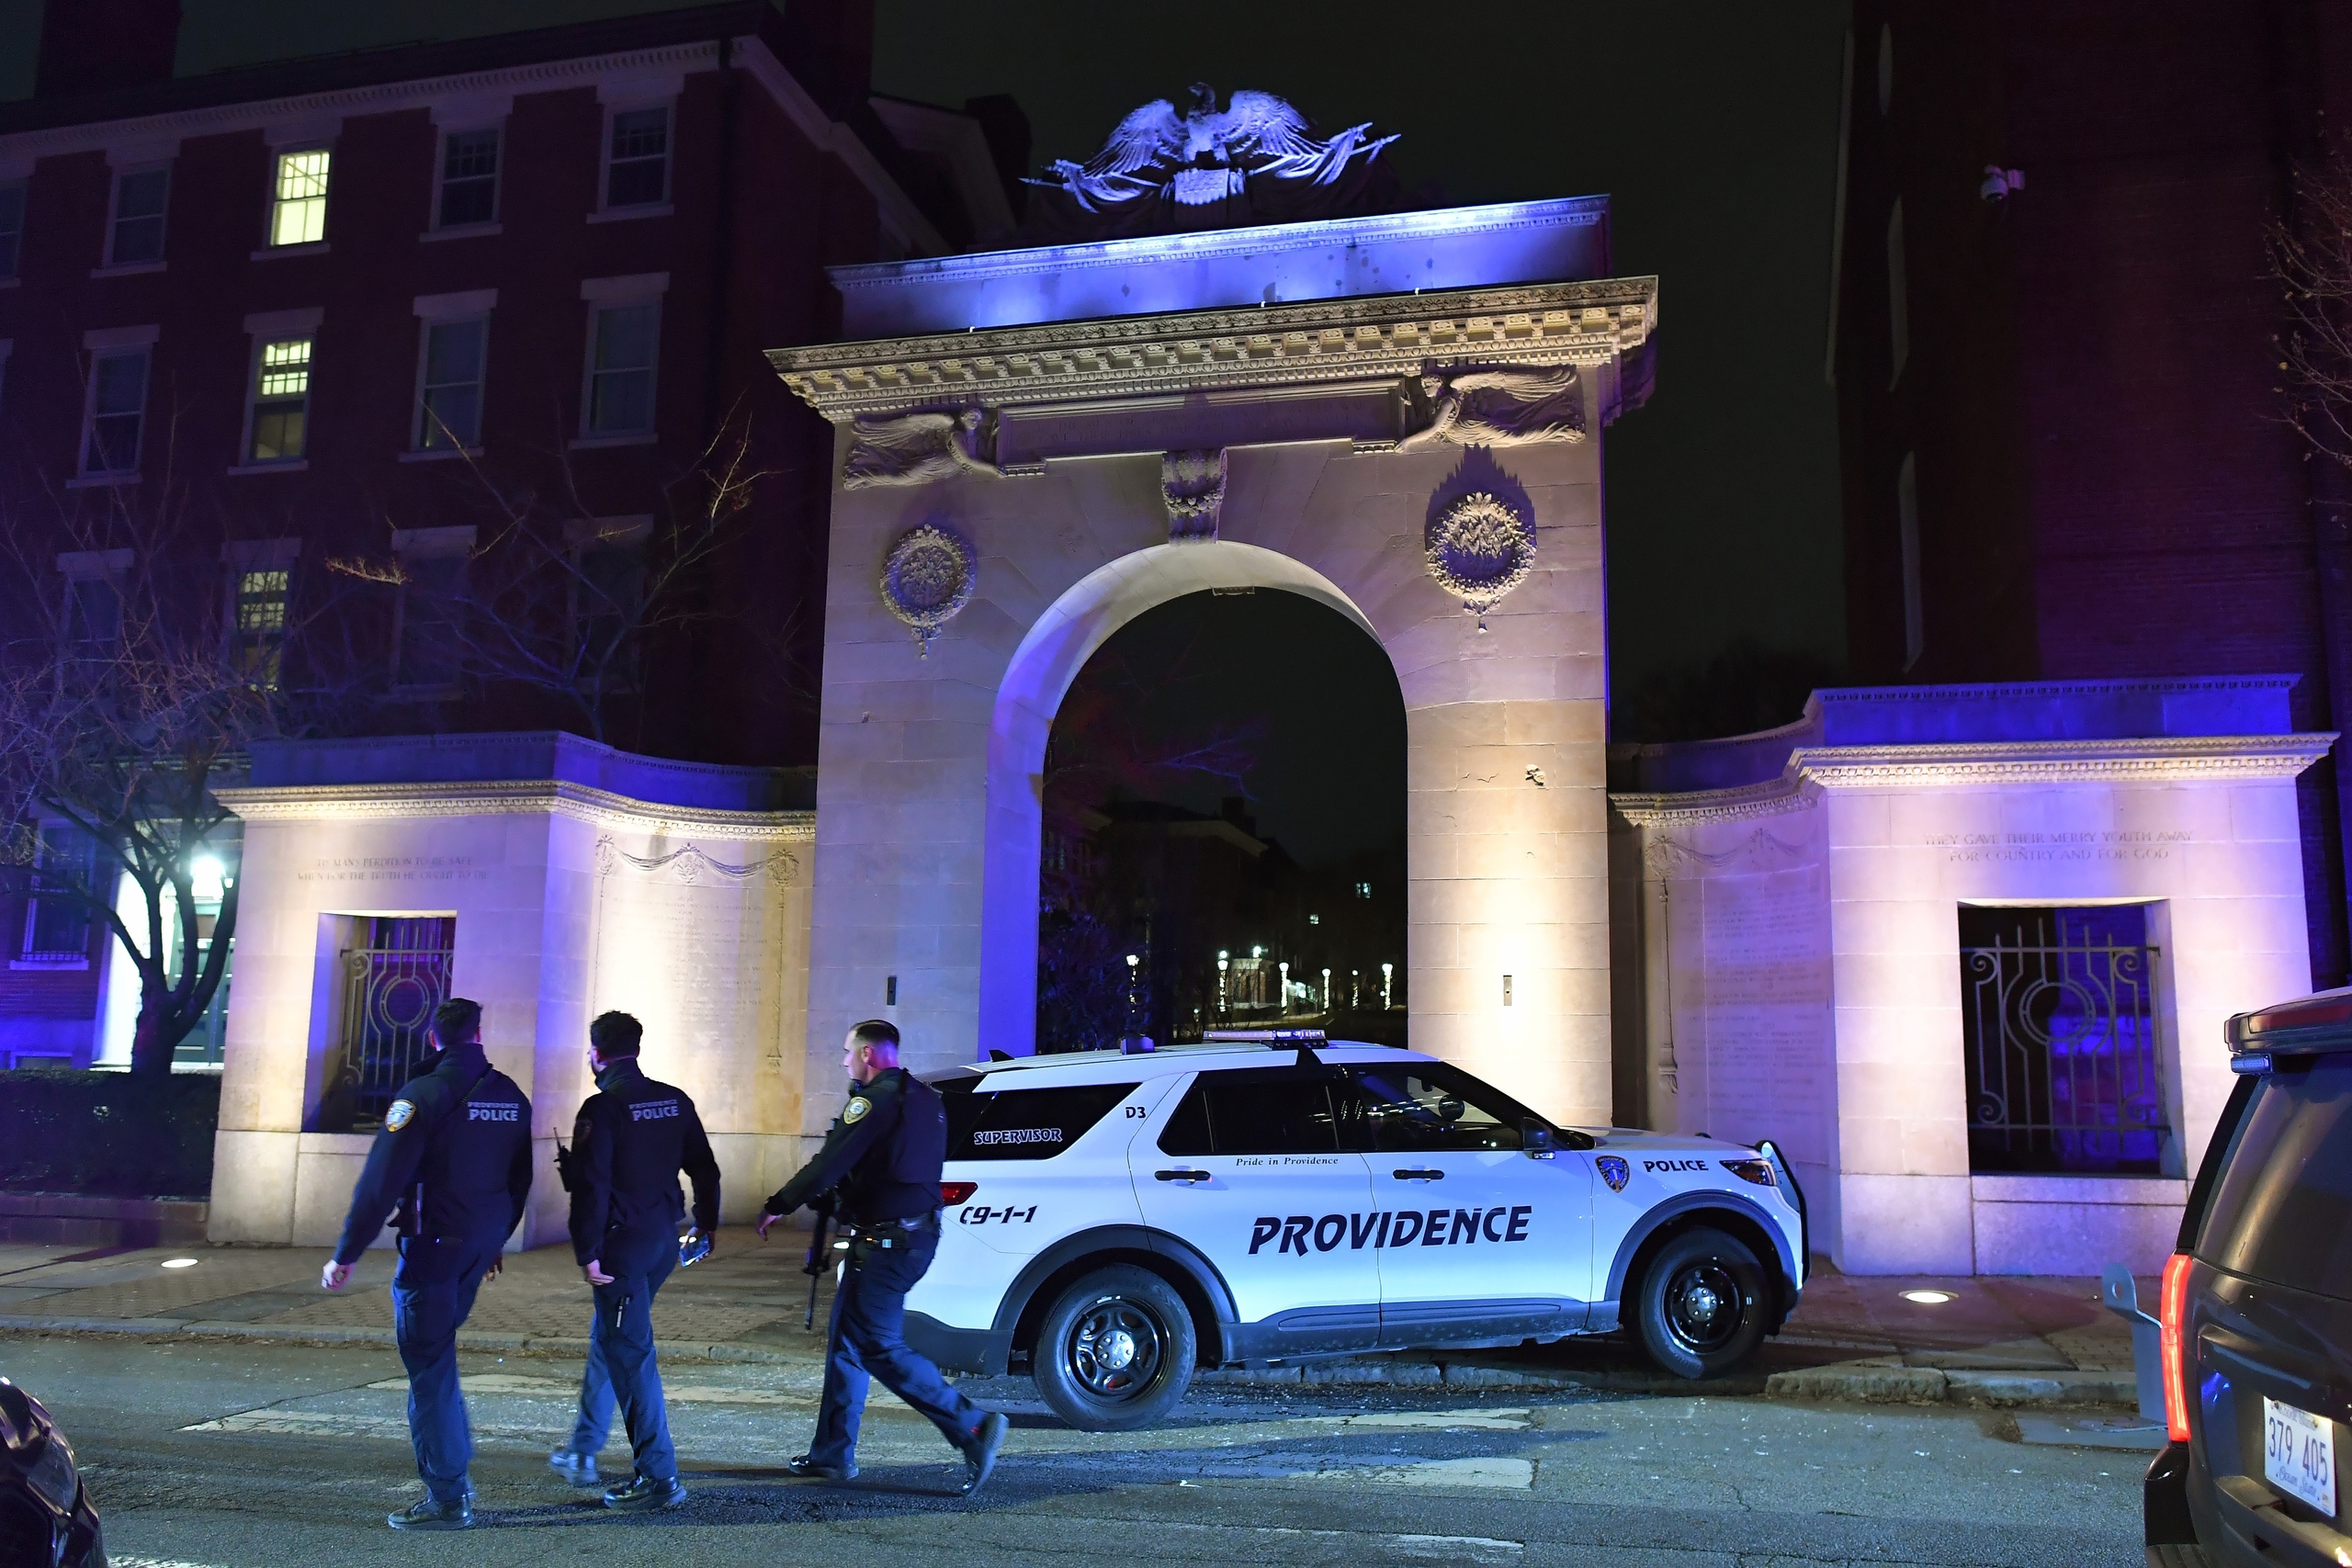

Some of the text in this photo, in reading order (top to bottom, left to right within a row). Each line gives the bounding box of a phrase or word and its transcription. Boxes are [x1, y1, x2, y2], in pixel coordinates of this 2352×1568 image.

[1963, 833, 2000, 845] GAVE
[2156, 830, 2194, 841] AWAY
[1950, 850, 1980, 862] FOR
[1985, 849, 2055, 862] COUNTRY
[2060, 849, 2091, 860] AND
[2133, 848, 2169, 860] GOD
[469, 1110, 519, 1122] POLICE
[632, 1106, 679, 1122] POLICE
[1125, 1106, 1147, 1119] D3
[974, 1128, 1063, 1145] SUPERVISOR
[1236, 1156, 1340, 1168] Pride in Providence
[1644, 1159, 1709, 1174] POLICE
[1248, 1205, 1532, 1258] PROVIDENCE
[2268, 1416, 2328, 1486] 379 405
